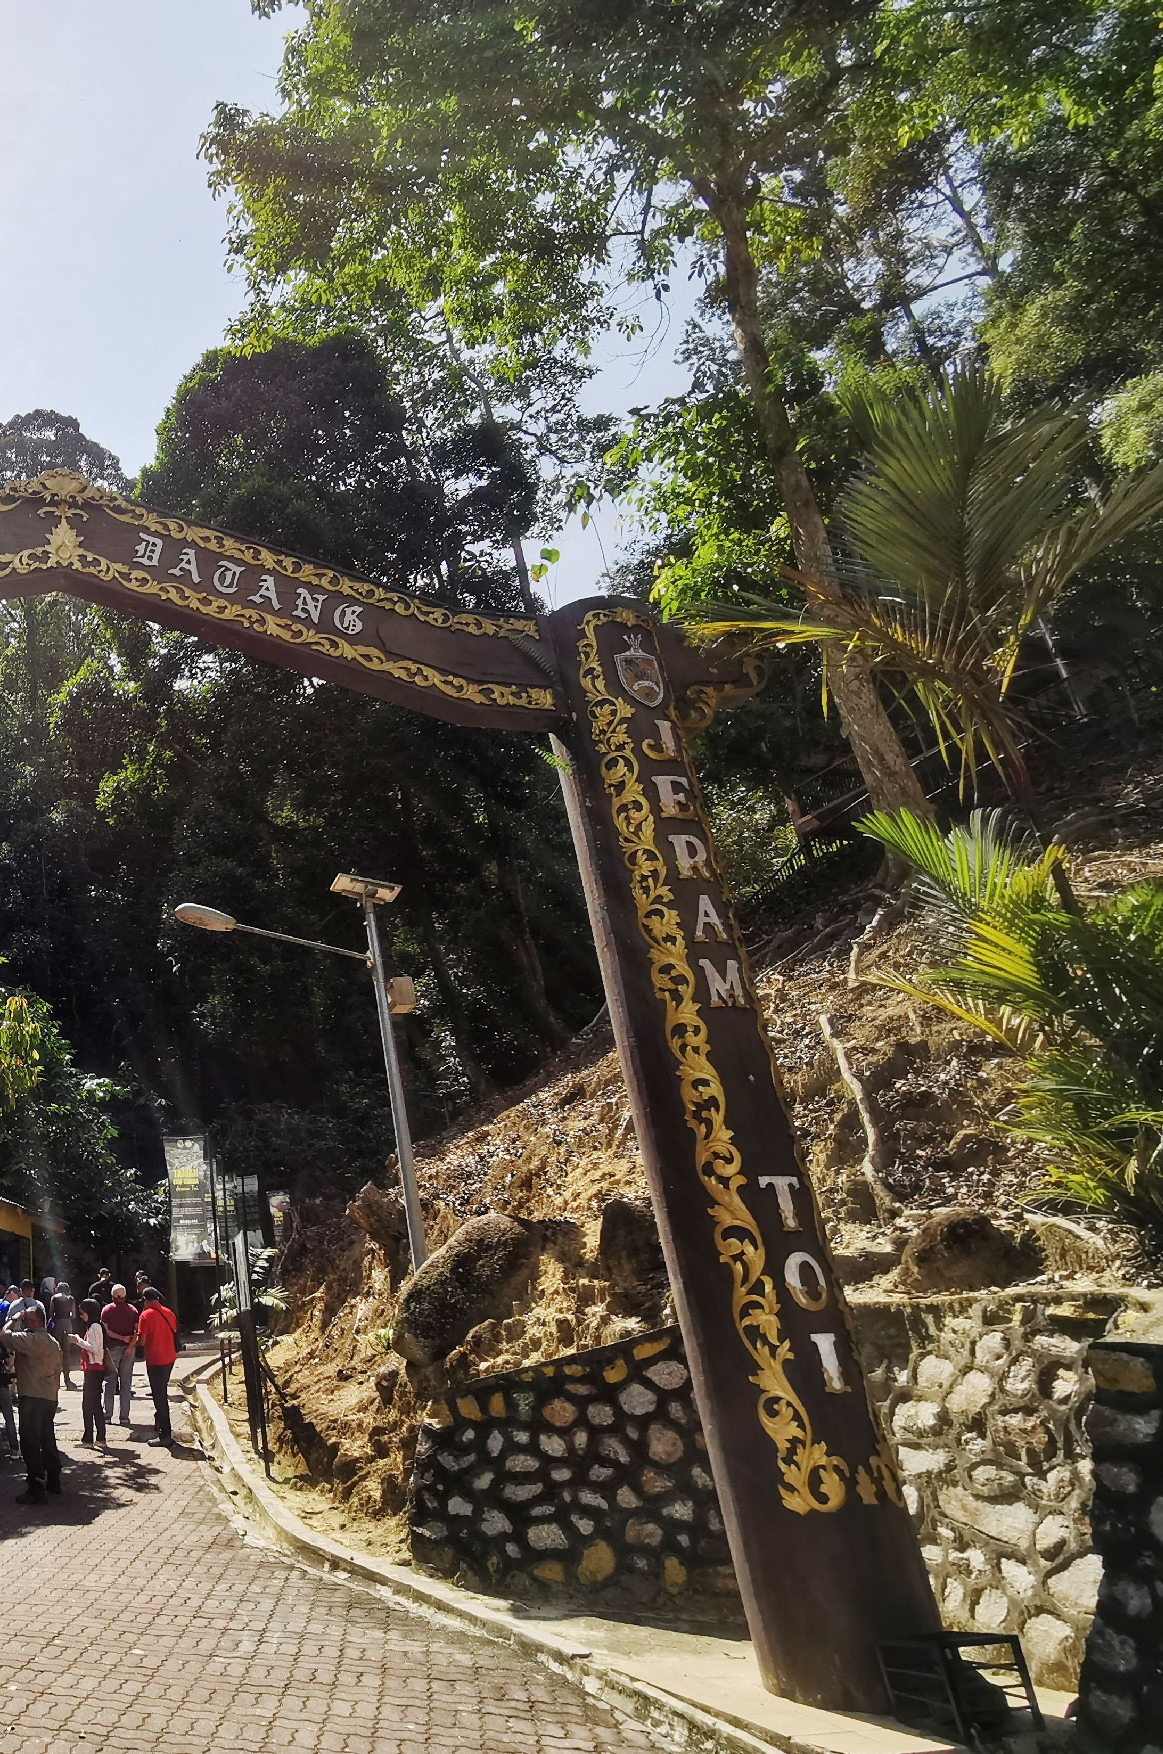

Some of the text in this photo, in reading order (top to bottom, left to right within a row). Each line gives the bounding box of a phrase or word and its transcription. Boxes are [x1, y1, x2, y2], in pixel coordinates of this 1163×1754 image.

[133, 532, 364, 635] DATANG
[642, 719, 852, 1393] JERAM TOI
